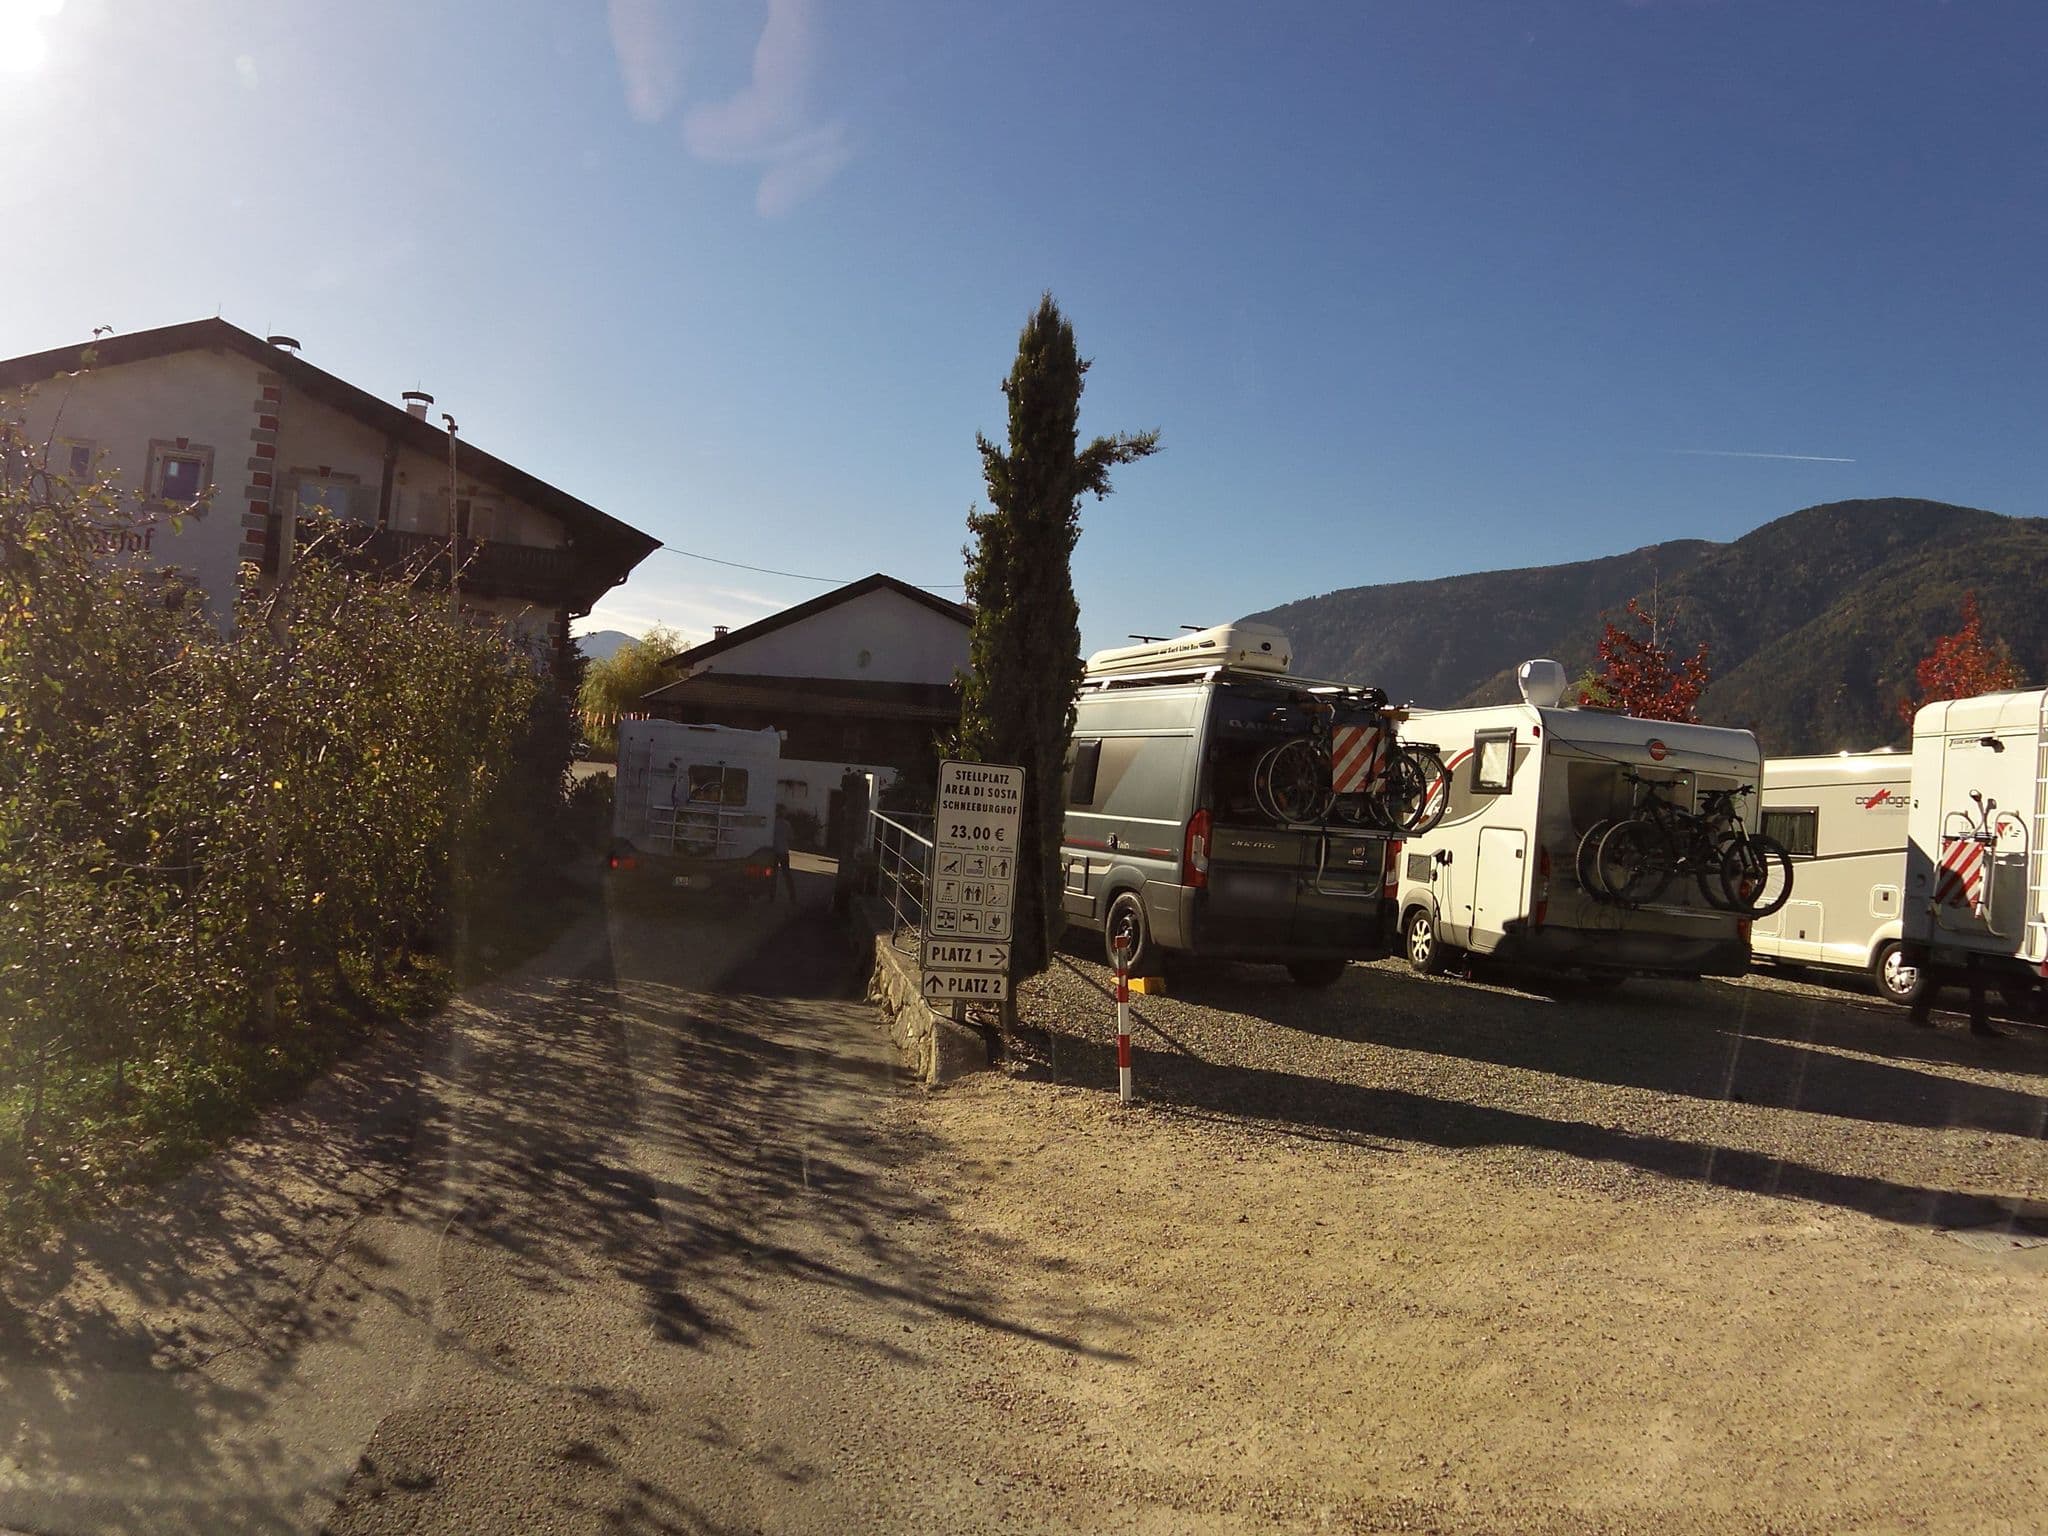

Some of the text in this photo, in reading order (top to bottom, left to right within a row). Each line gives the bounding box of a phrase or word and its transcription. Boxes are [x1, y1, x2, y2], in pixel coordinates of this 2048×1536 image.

[955, 770, 1010, 785] STELLPLATZ
[944, 784, 1018, 800] AREA DI SOSTA
[942, 800, 1018, 816] SCHNEEBURGHOF
[950, 824, 1005, 842] 23,00 €
[932, 946, 983, 963] PLATZ 1
[948, 977, 1001, 994] PLATZ 2
